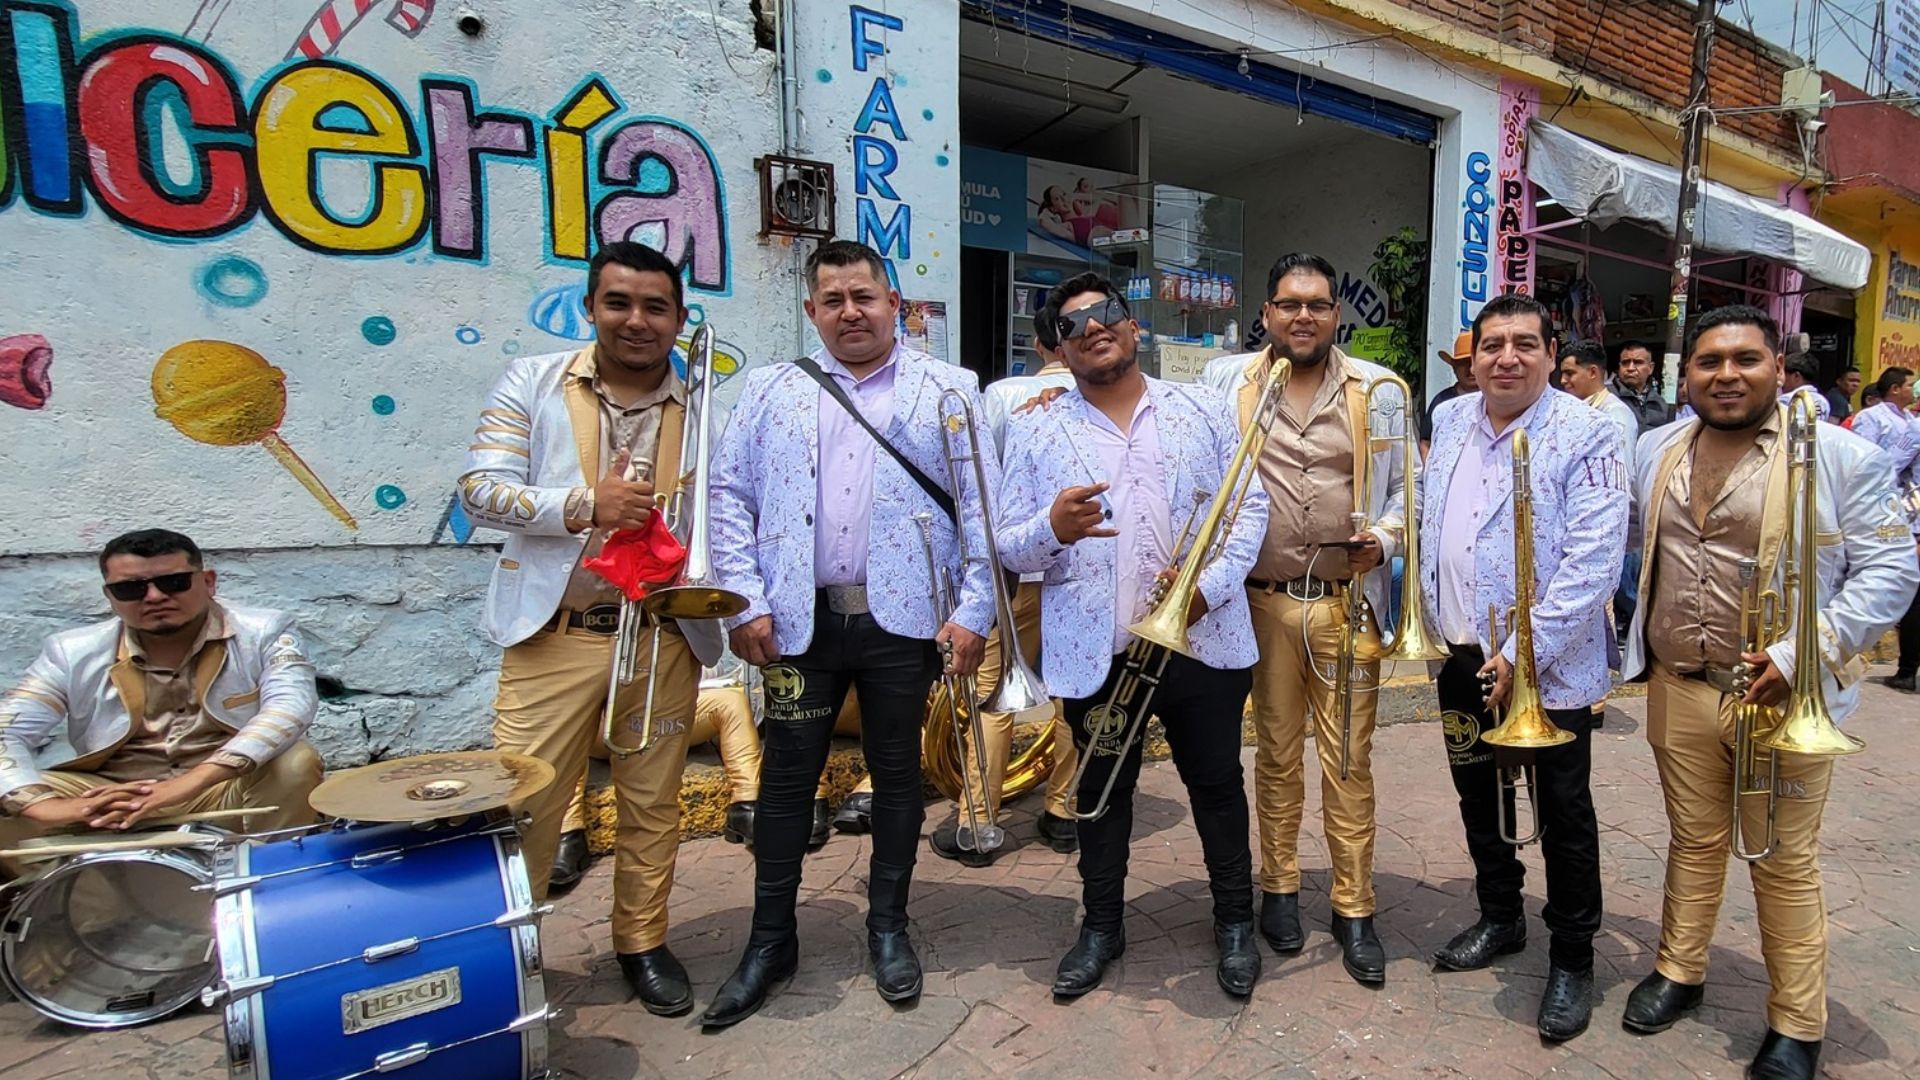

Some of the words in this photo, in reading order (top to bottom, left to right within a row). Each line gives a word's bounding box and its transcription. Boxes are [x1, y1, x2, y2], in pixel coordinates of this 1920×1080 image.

[1504, 92, 1528, 158] COPIAS
[0, 0, 732, 295] lcería
[1500, 179, 1530, 295] PAPE
[461, 477, 541, 521] CDS
[586, 614, 620, 626] BCD
[1326, 663, 1373, 682] BDS
[362, 979, 448, 1019] HERCH
